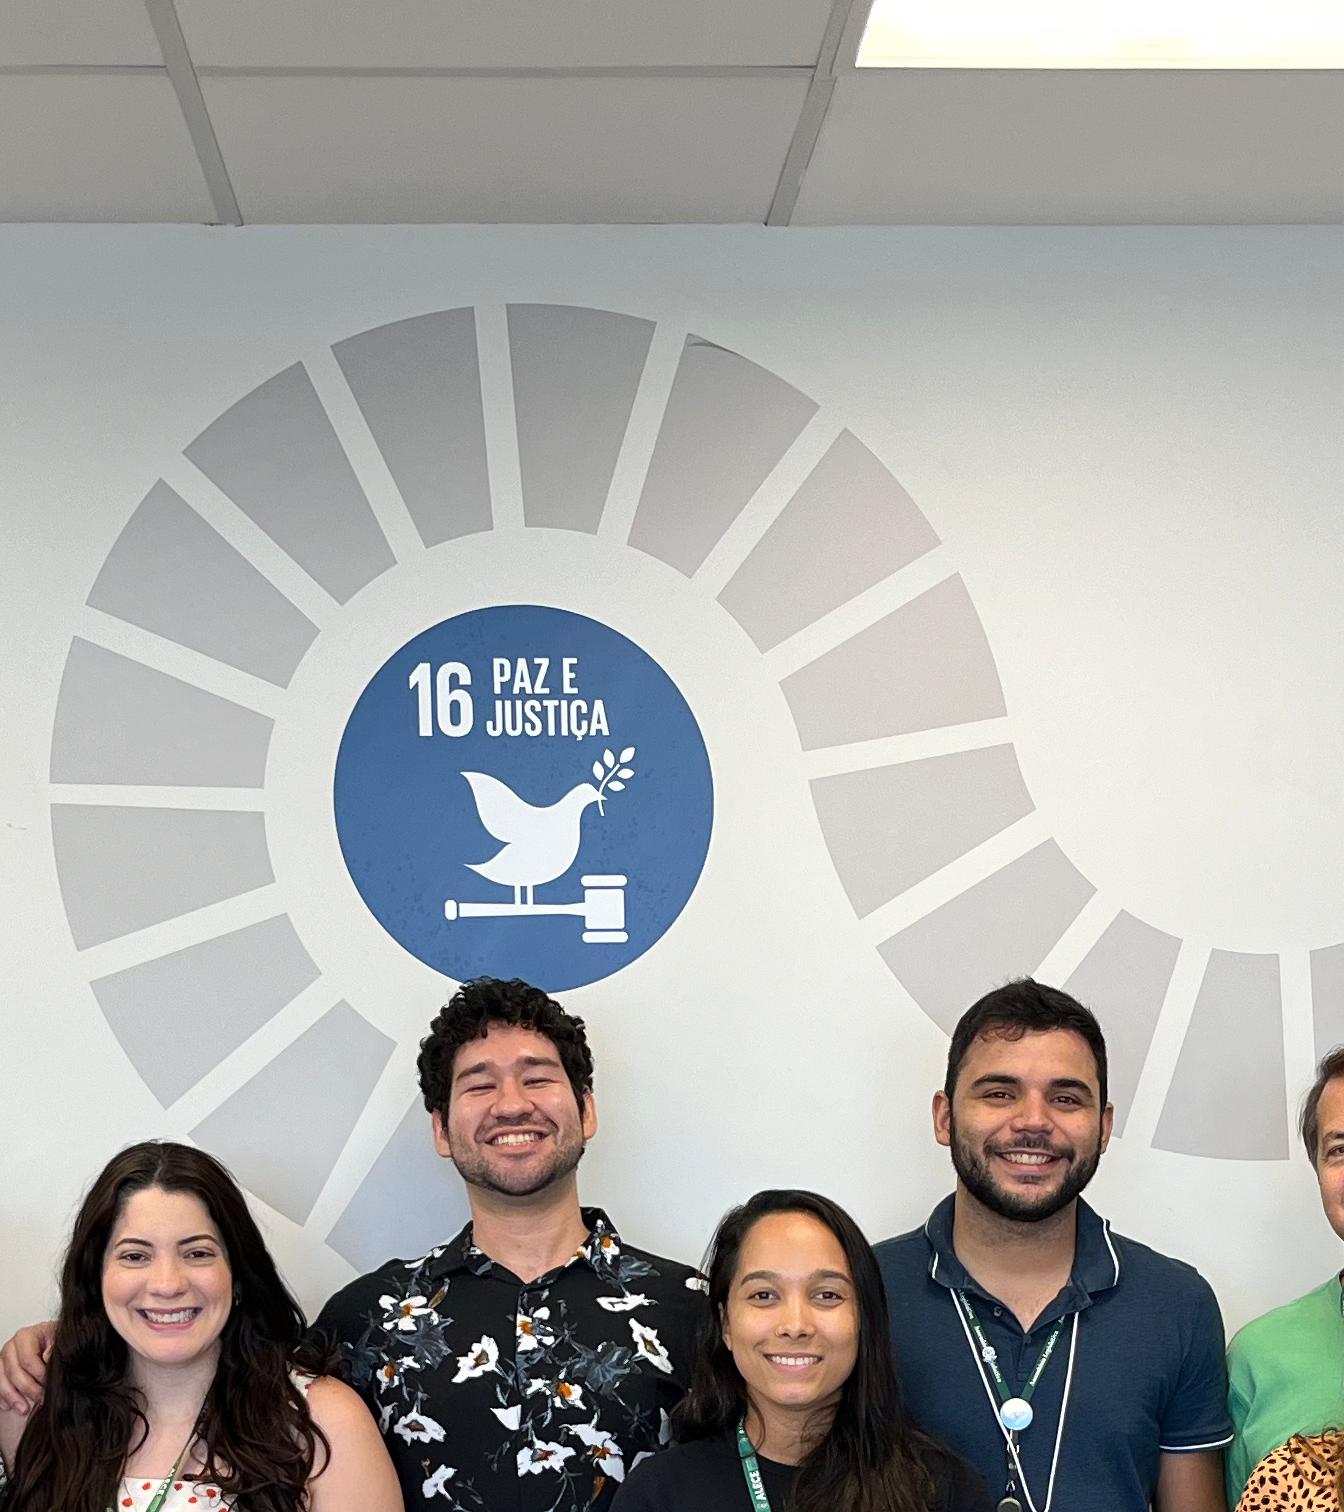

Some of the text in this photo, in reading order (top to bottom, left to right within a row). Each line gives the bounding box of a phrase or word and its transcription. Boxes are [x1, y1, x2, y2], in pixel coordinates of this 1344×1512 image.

[493, 657, 578, 694] PAZ E
[408, 661, 474, 738] 16
[486, 699, 610, 740] JUSTIÇA
[749, 1469, 768, 1501] ALECE
